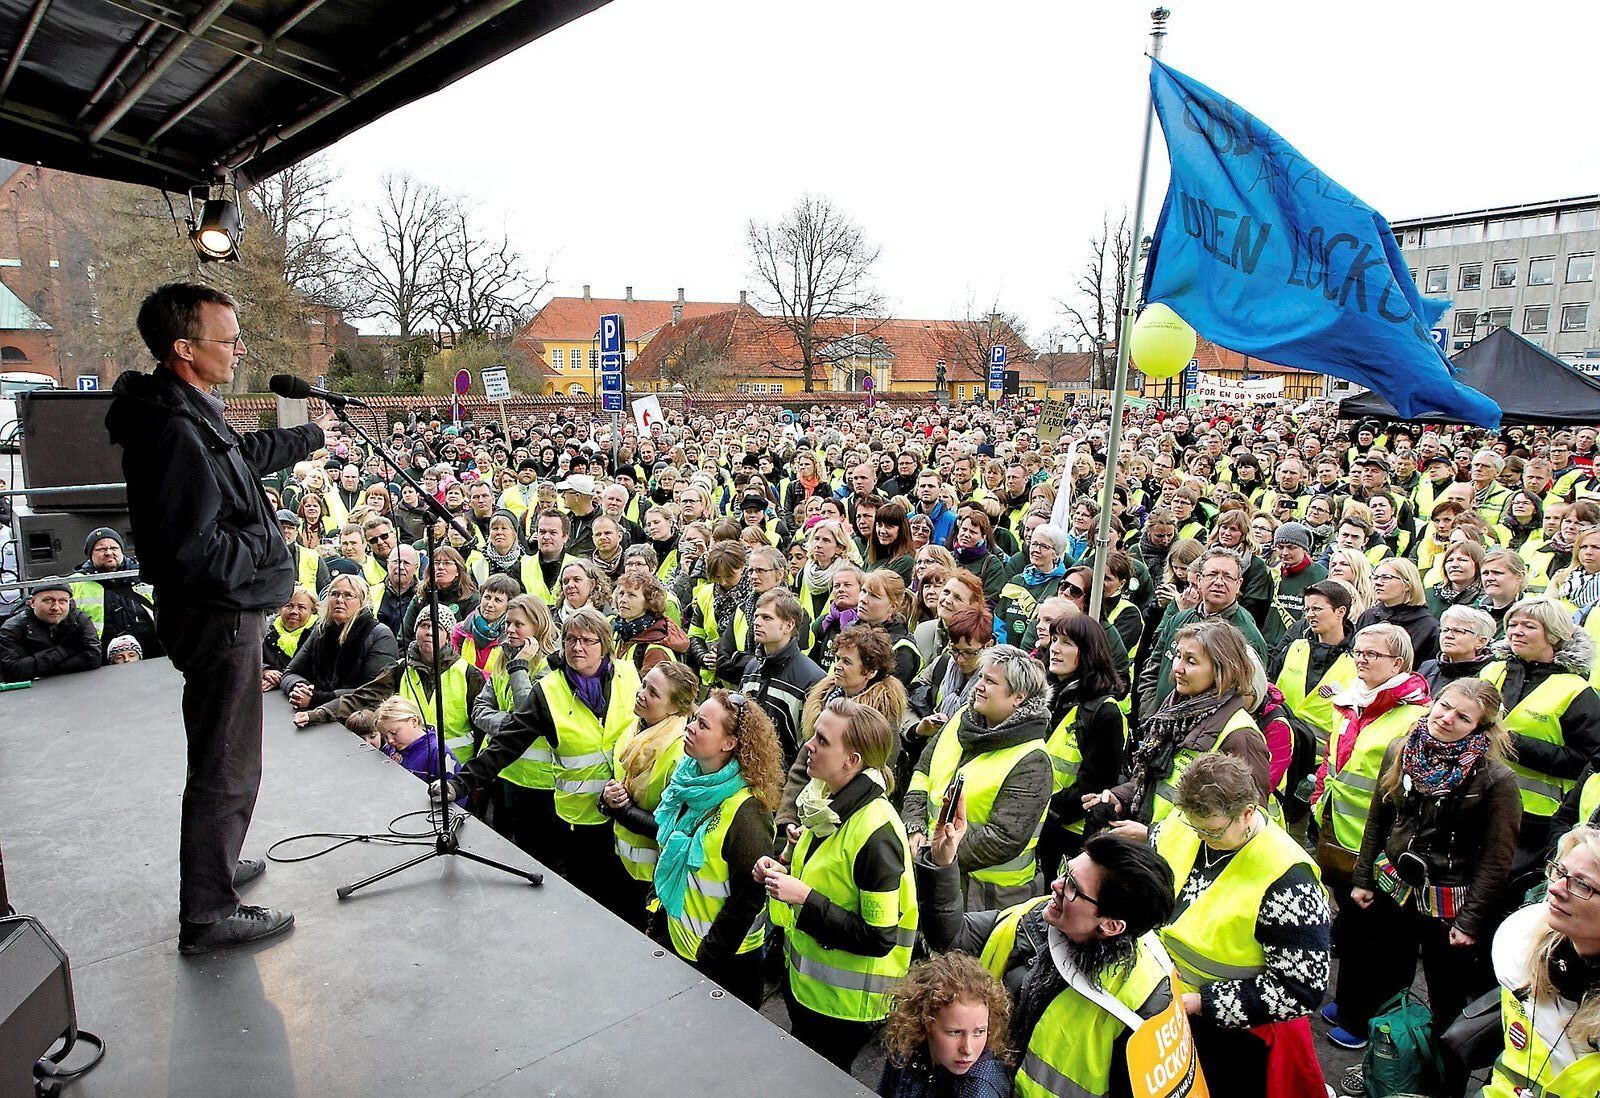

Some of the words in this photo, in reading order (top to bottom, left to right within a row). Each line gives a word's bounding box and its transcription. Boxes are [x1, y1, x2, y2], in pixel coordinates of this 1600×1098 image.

[1180, 191, 1272, 276] UDEN
[605, 319, 616, 349] P
[994, 347, 1003, 362] P
[1190, 360, 1197, 371] P
[82, 379, 95, 390] P
[1199, 387, 1216, 396] FOR
[1220, 390, 1231, 398] EN
[1255, 390, 1285, 400] SKOLE
[1155, 1015, 1179, 1058] JEG
